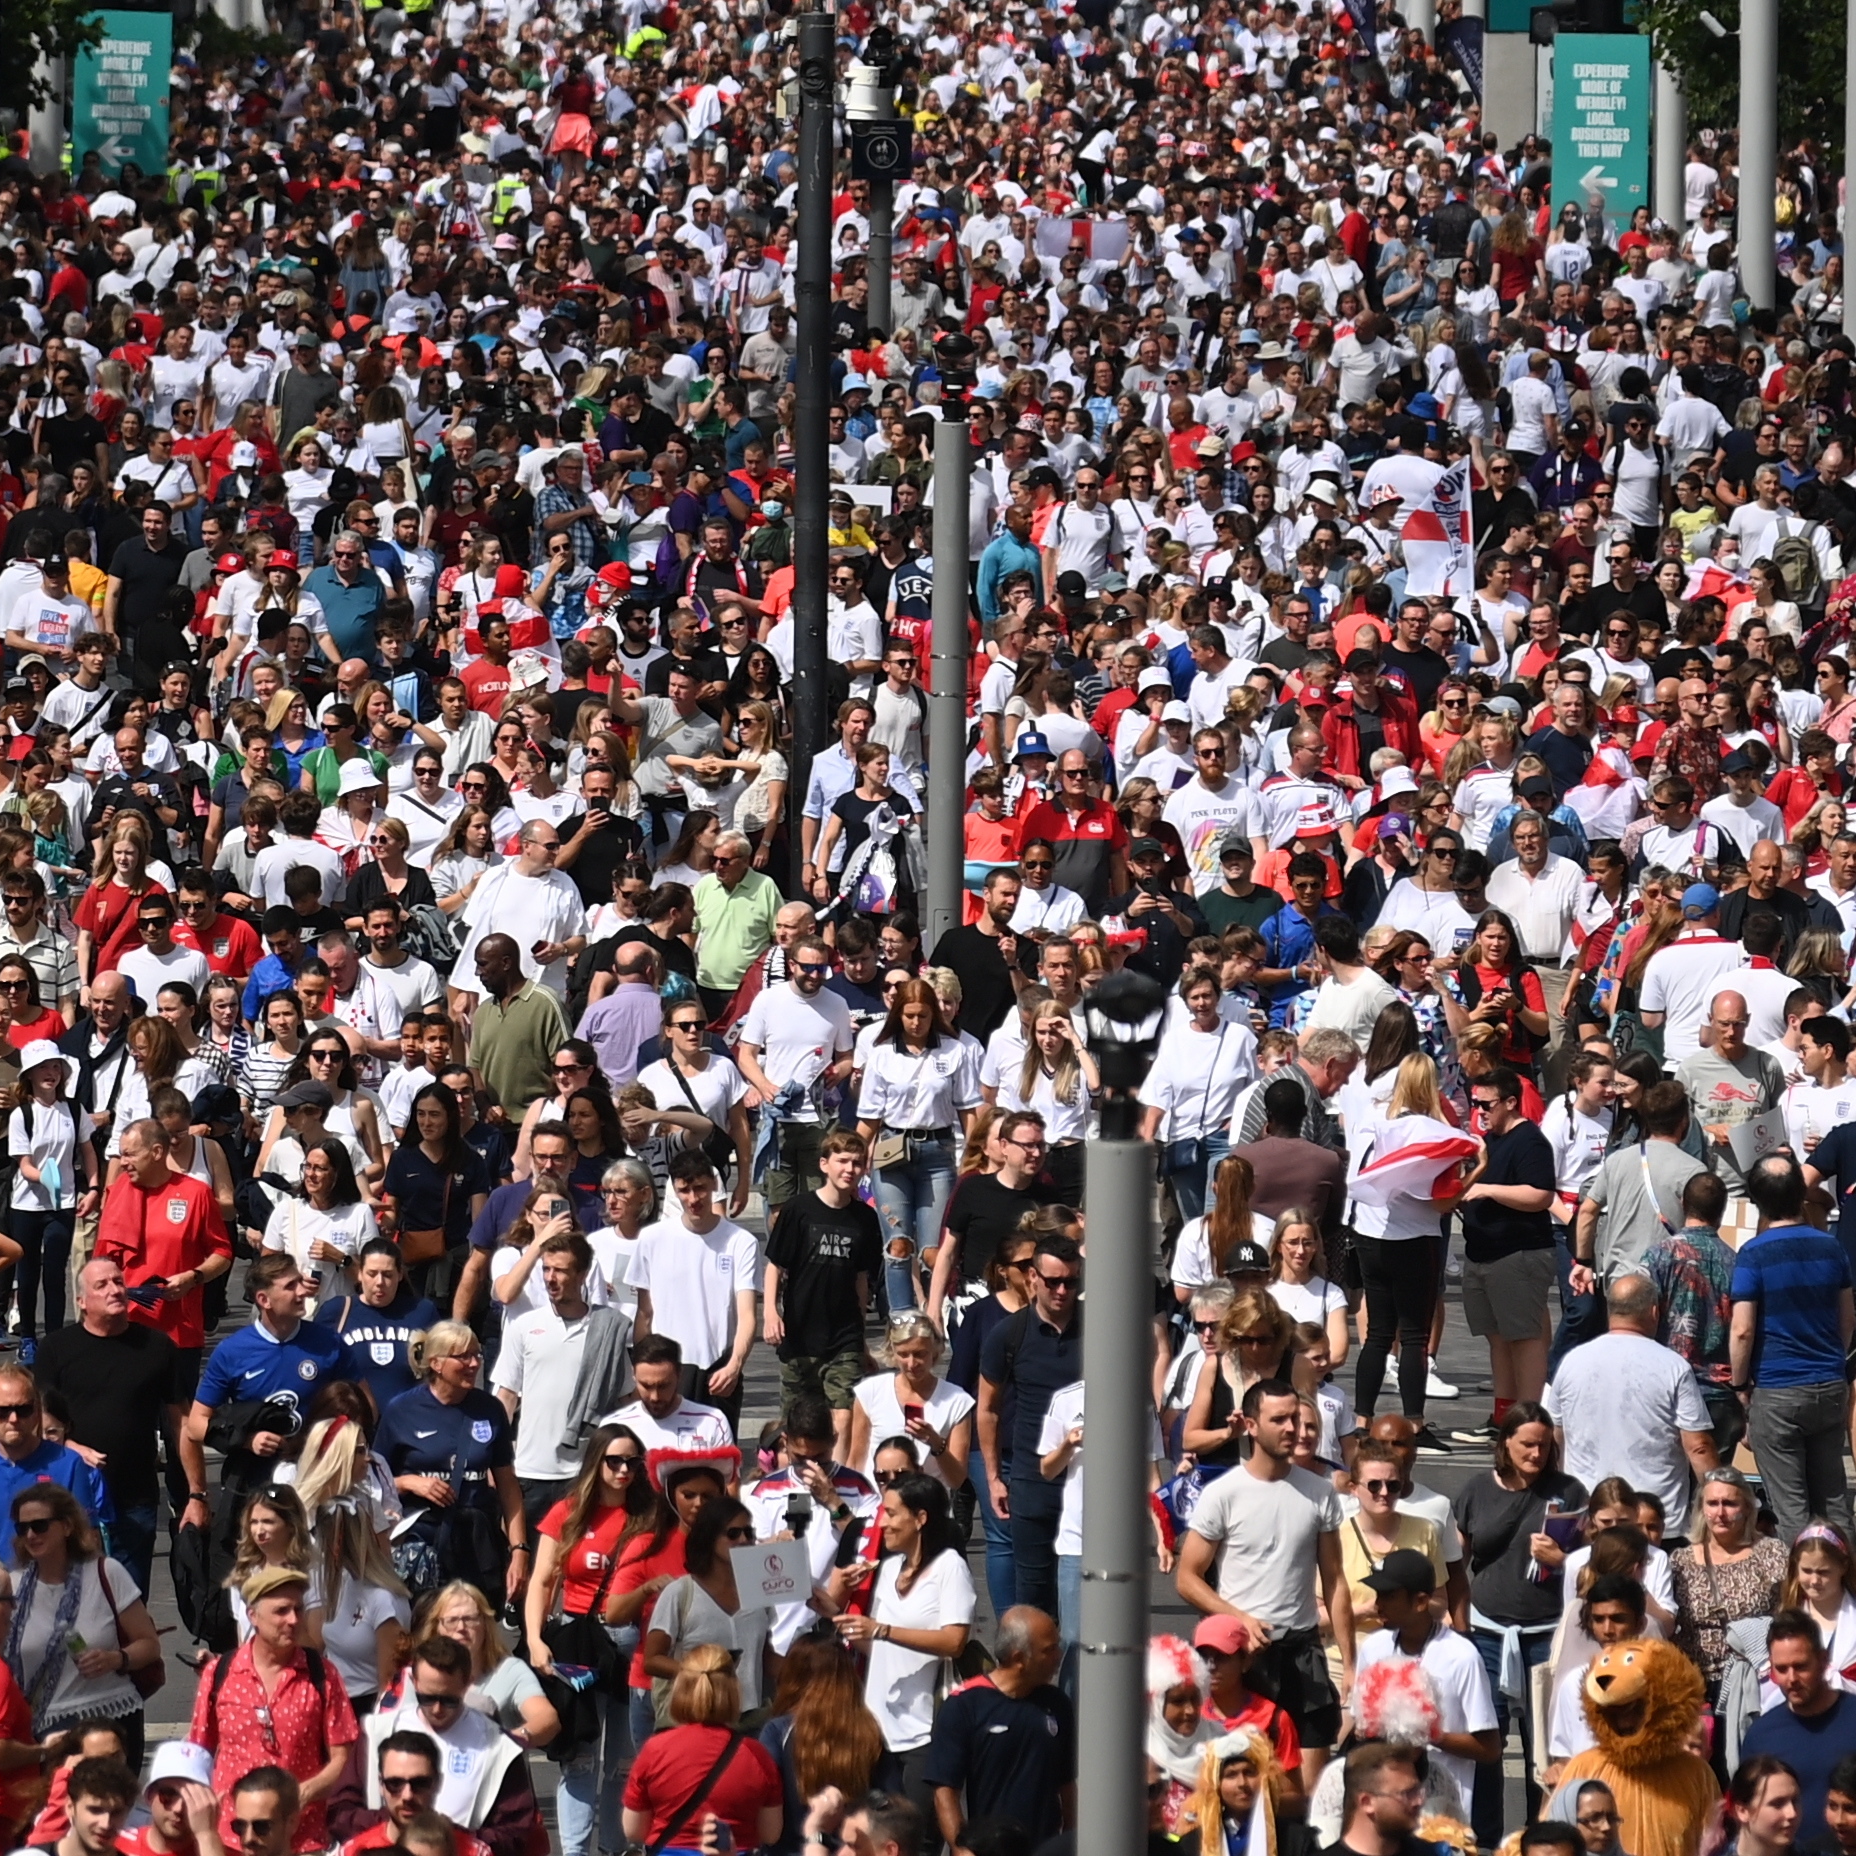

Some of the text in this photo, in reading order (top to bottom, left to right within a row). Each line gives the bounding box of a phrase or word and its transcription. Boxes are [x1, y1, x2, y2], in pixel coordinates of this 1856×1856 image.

[102, 56, 144, 71] MORE OF
[1573, 63, 1630, 79] EXPERIENCE
[1581, 79, 1622, 94] MORE OF
[1576, 95, 1626, 110] WEMBLEY!
[1586, 111, 1615, 126] LOCAL
[1571, 127, 1630, 142] BUSINESSES
[1578, 143, 1623, 158] THIS WAY
[1190, 807, 1238, 819] PINK FLOYD
[820, 1233, 839, 1245] AIR
[819, 1244, 851, 1259] MAX
